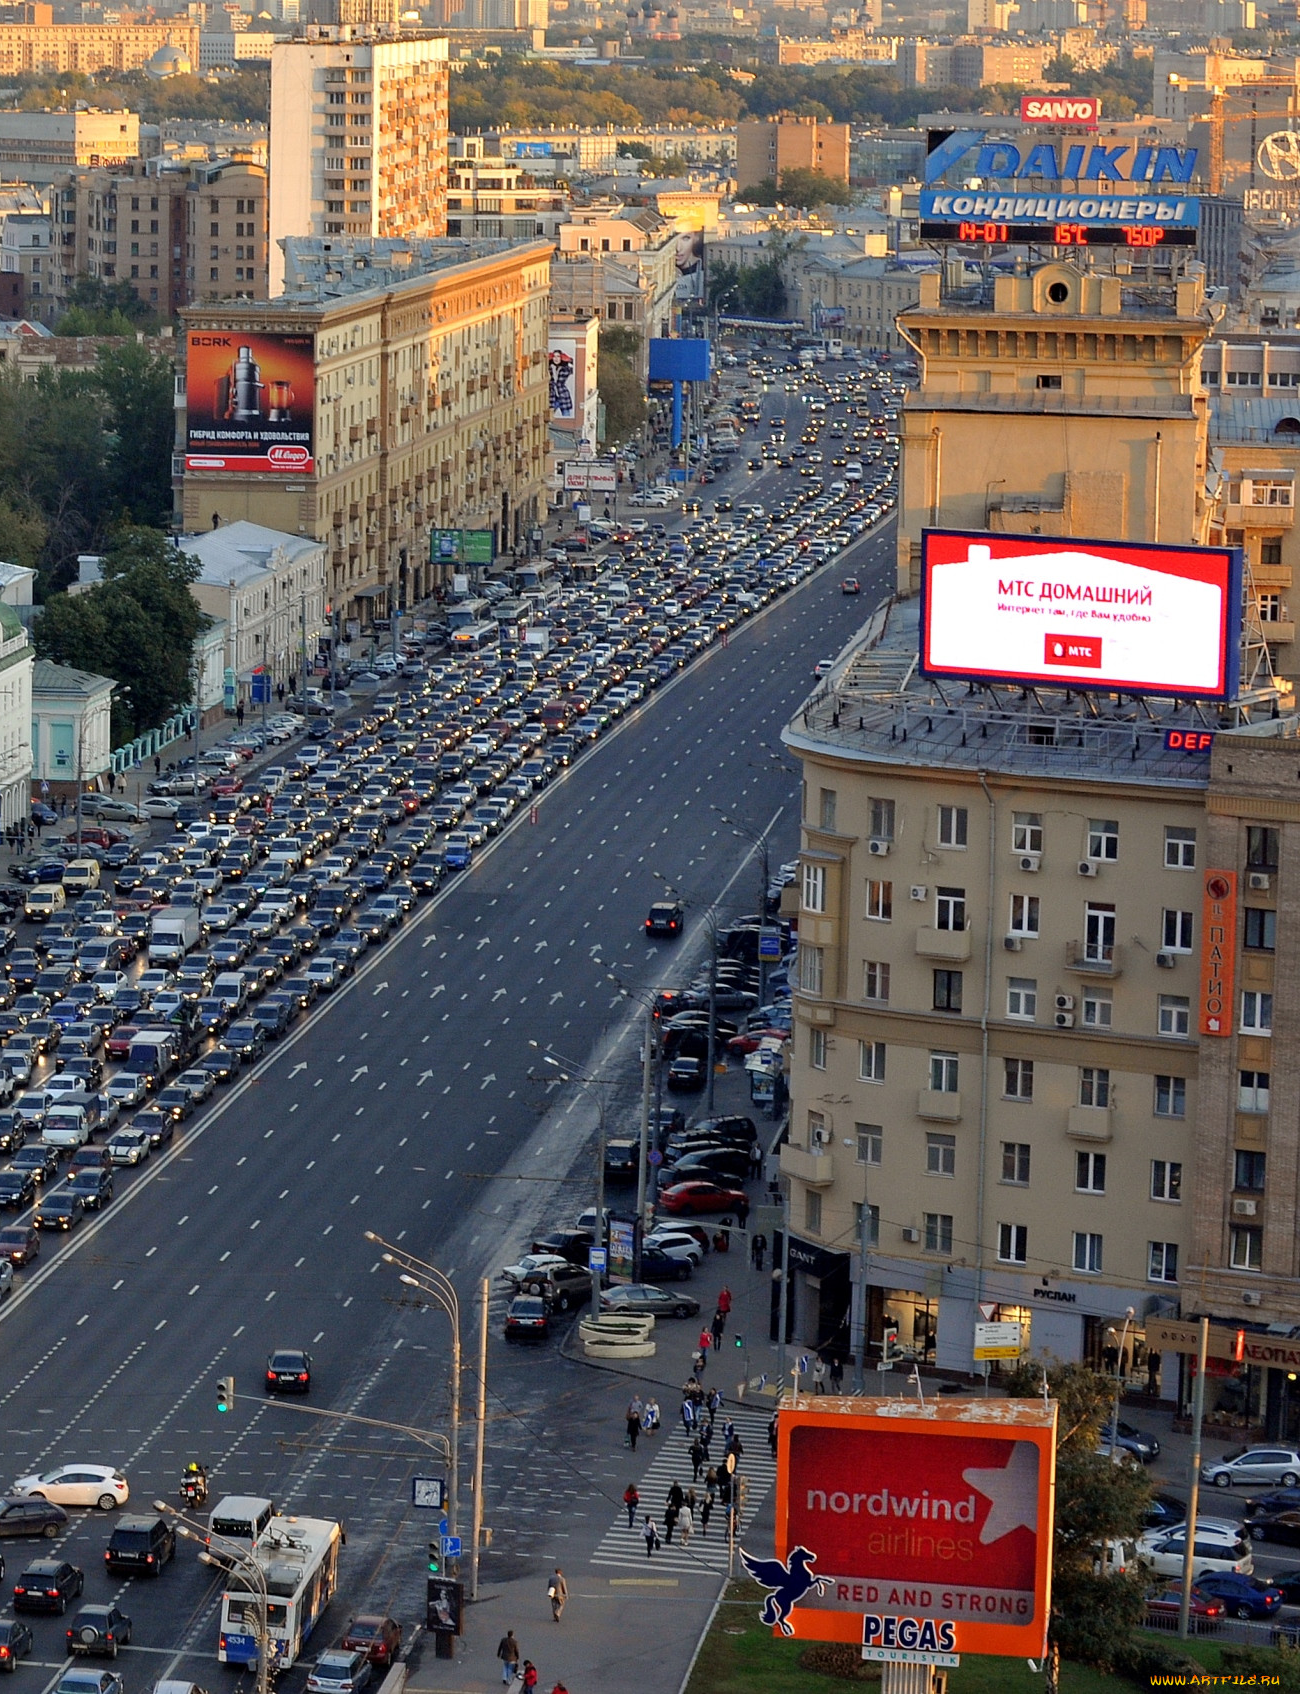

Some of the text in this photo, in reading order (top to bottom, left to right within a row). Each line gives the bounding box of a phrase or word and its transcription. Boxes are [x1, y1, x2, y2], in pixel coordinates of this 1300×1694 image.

[1026, 101, 1092, 119] SANYO
[975, 143, 1199, 181] DAIKIN
[931, 195, 1186, 221] КОНДИЦИОНЕРЫ
[959, 222, 1008, 243] 14-01
[192, 337, 231, 347] BORK
[216, 430, 252, 440] КОМФОРТА
[260, 431, 309, 441] УДОВОЛЬСТВИЯ
[998, 579, 1152, 606] МТС ДОМАШНИЙ
[998, 603, 1045, 614] Интернет
[1113, 614, 1151, 622] удобно
[1206, 927, 1225, 1015] ПАТИО
[789, 1248, 815, 1264] GANT
[1033, 1288, 1076, 1302] РУСЛАН
[806, 1488, 975, 1523] nordwind
[867, 1527, 974, 1561] airlines
[836, 1584, 1028, 1614] RED AND STRONG
[863, 1613, 956, 1651] PEGAS
[866, 1650, 957, 1664] TOURISTIK
